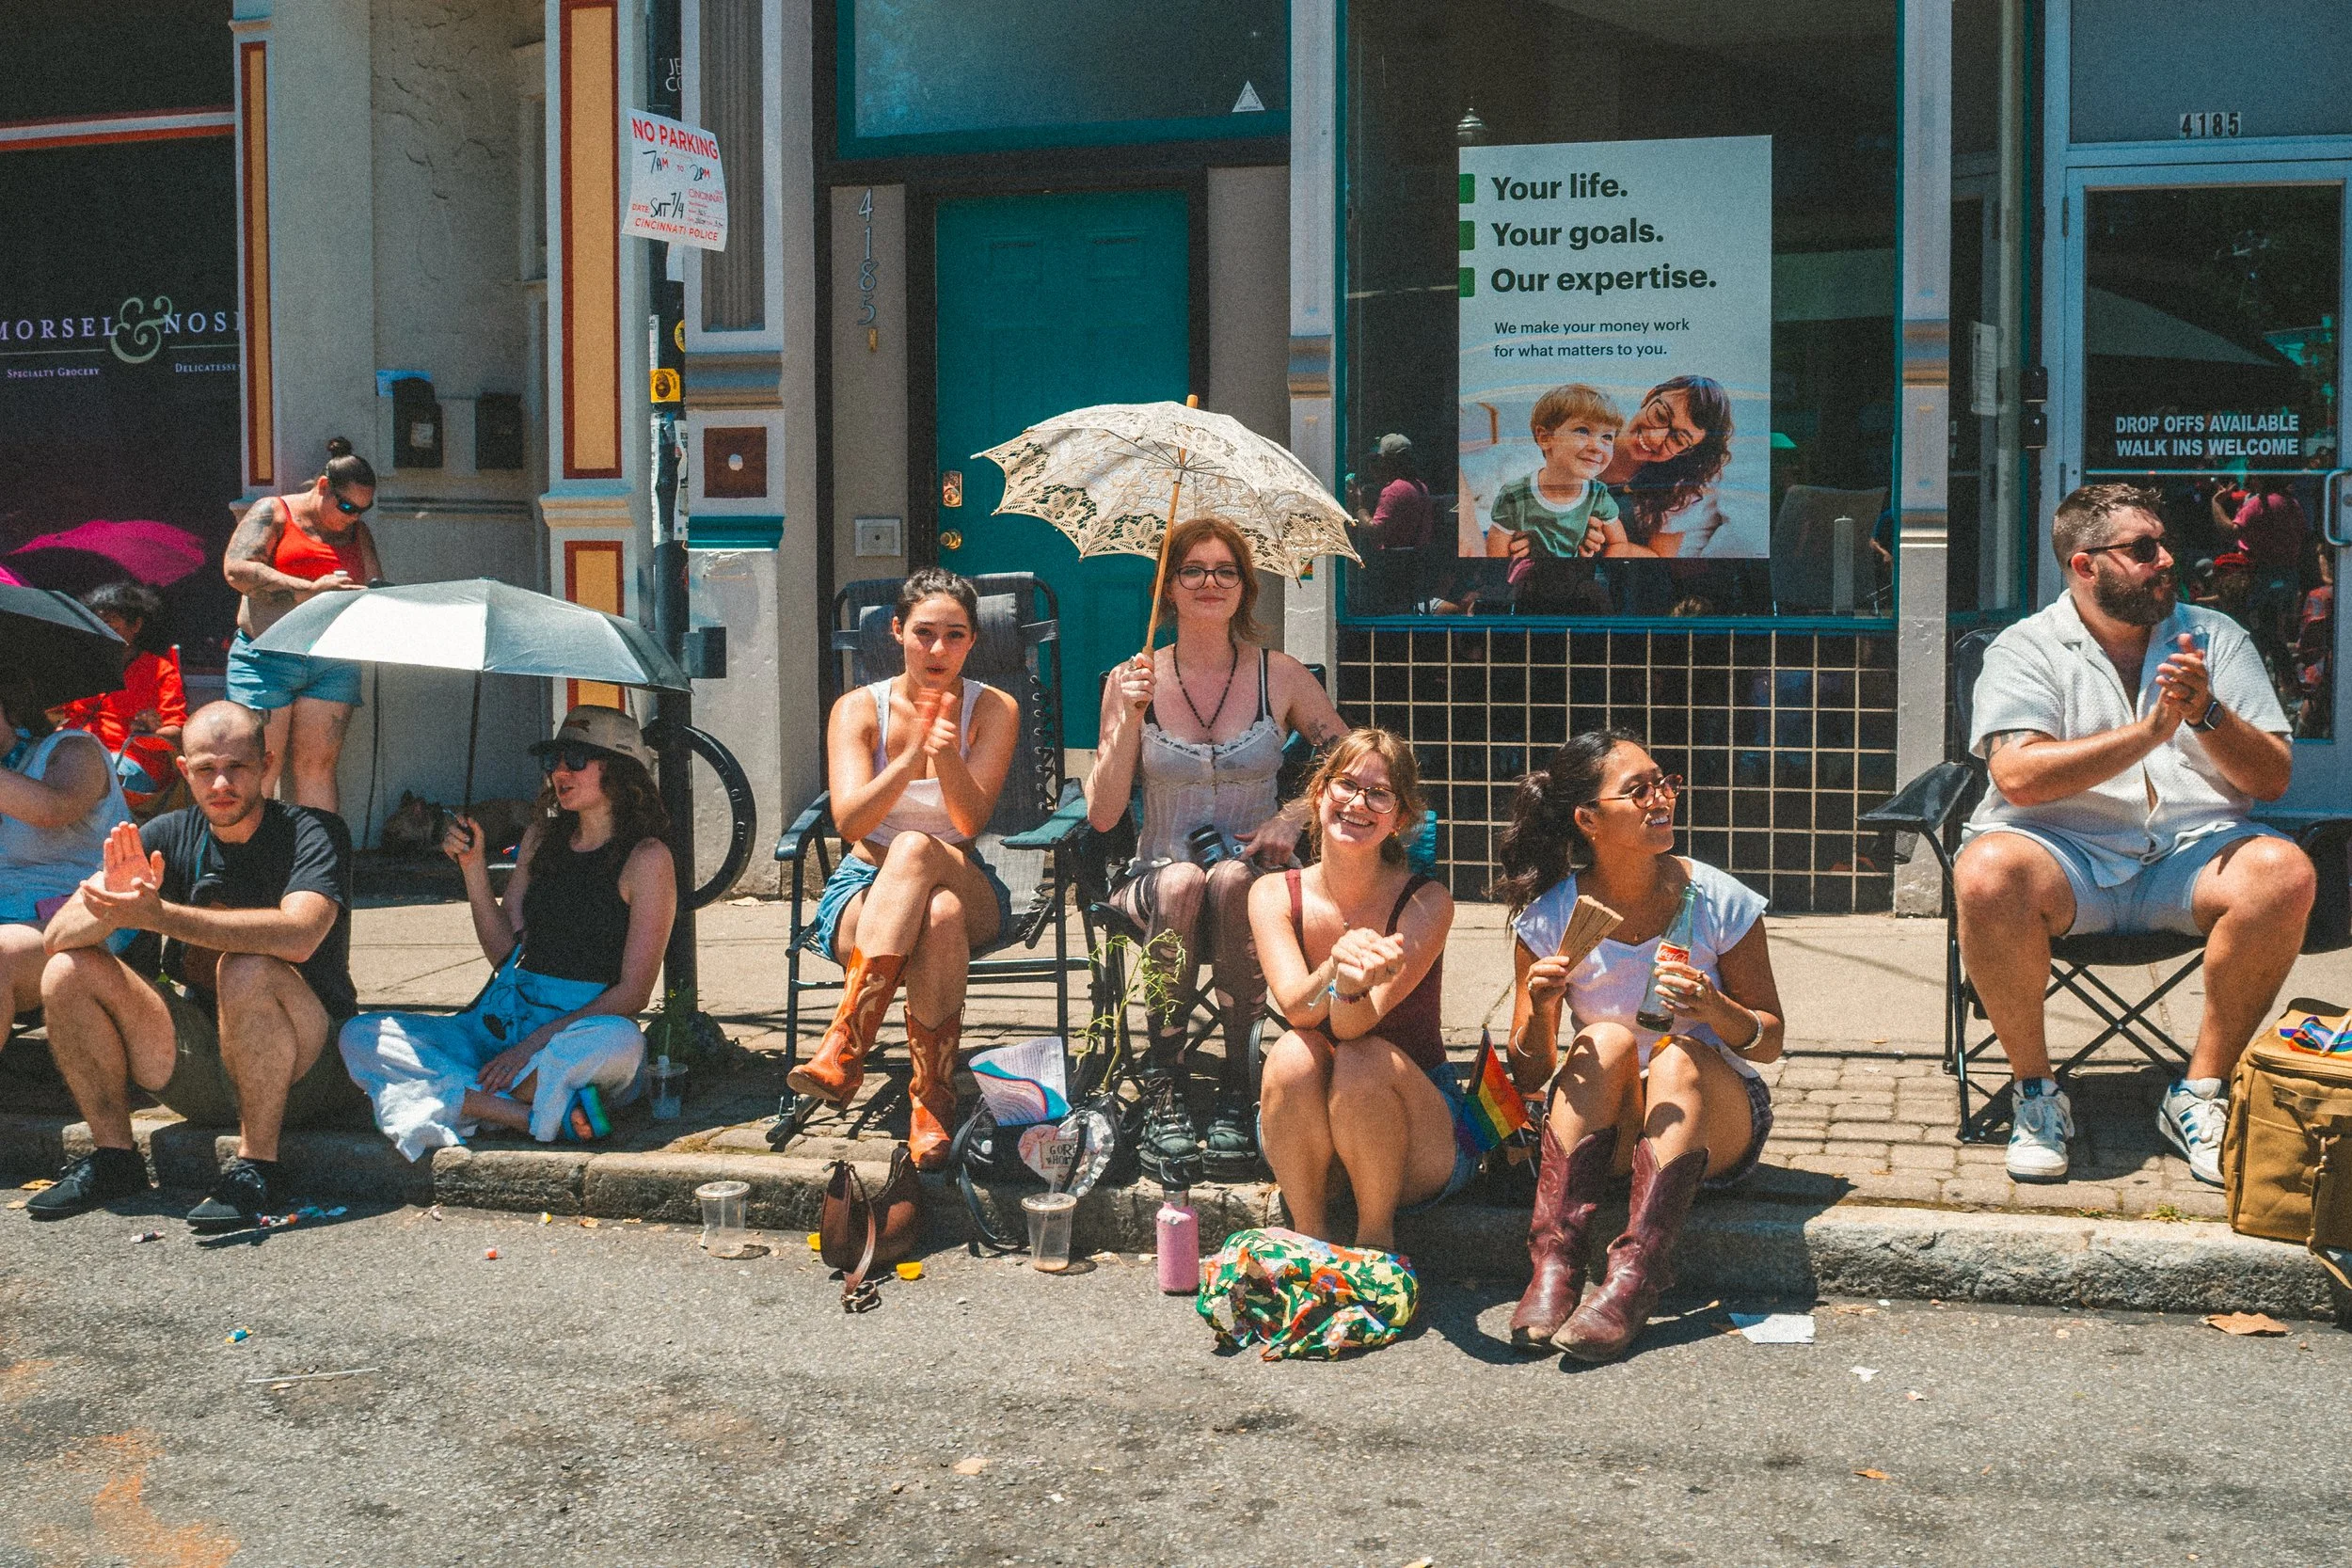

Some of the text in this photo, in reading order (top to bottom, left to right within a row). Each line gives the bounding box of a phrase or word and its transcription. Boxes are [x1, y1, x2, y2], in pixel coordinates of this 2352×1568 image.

[2182, 112, 2239, 138] 4185
[631, 118, 719, 159] NO PARKING
[643, 150, 669, 174] 7AM
[1491, 171, 1629, 200] Your life.
[671, 191, 684, 219] 7/4
[635, 216, 687, 234] CINCINNATI
[689, 227, 718, 242] POLICE
[1491, 217, 1664, 250] Your goals.
[858, 187, 878, 325] 4185
[1491, 263, 1717, 295] Our expertise.
[1494, 318, 1690, 337] We make your money work
[1494, 343, 1667, 359] for what matters to you.
[7, 367, 100, 378] SPECIALTY GROCERY
[175, 362, 240, 373] DELICATESSE
[2116, 414, 2299, 433] DROP OFFS AVAILABLE
[2117, 437, 2298, 456] WALK INS WELCOME
